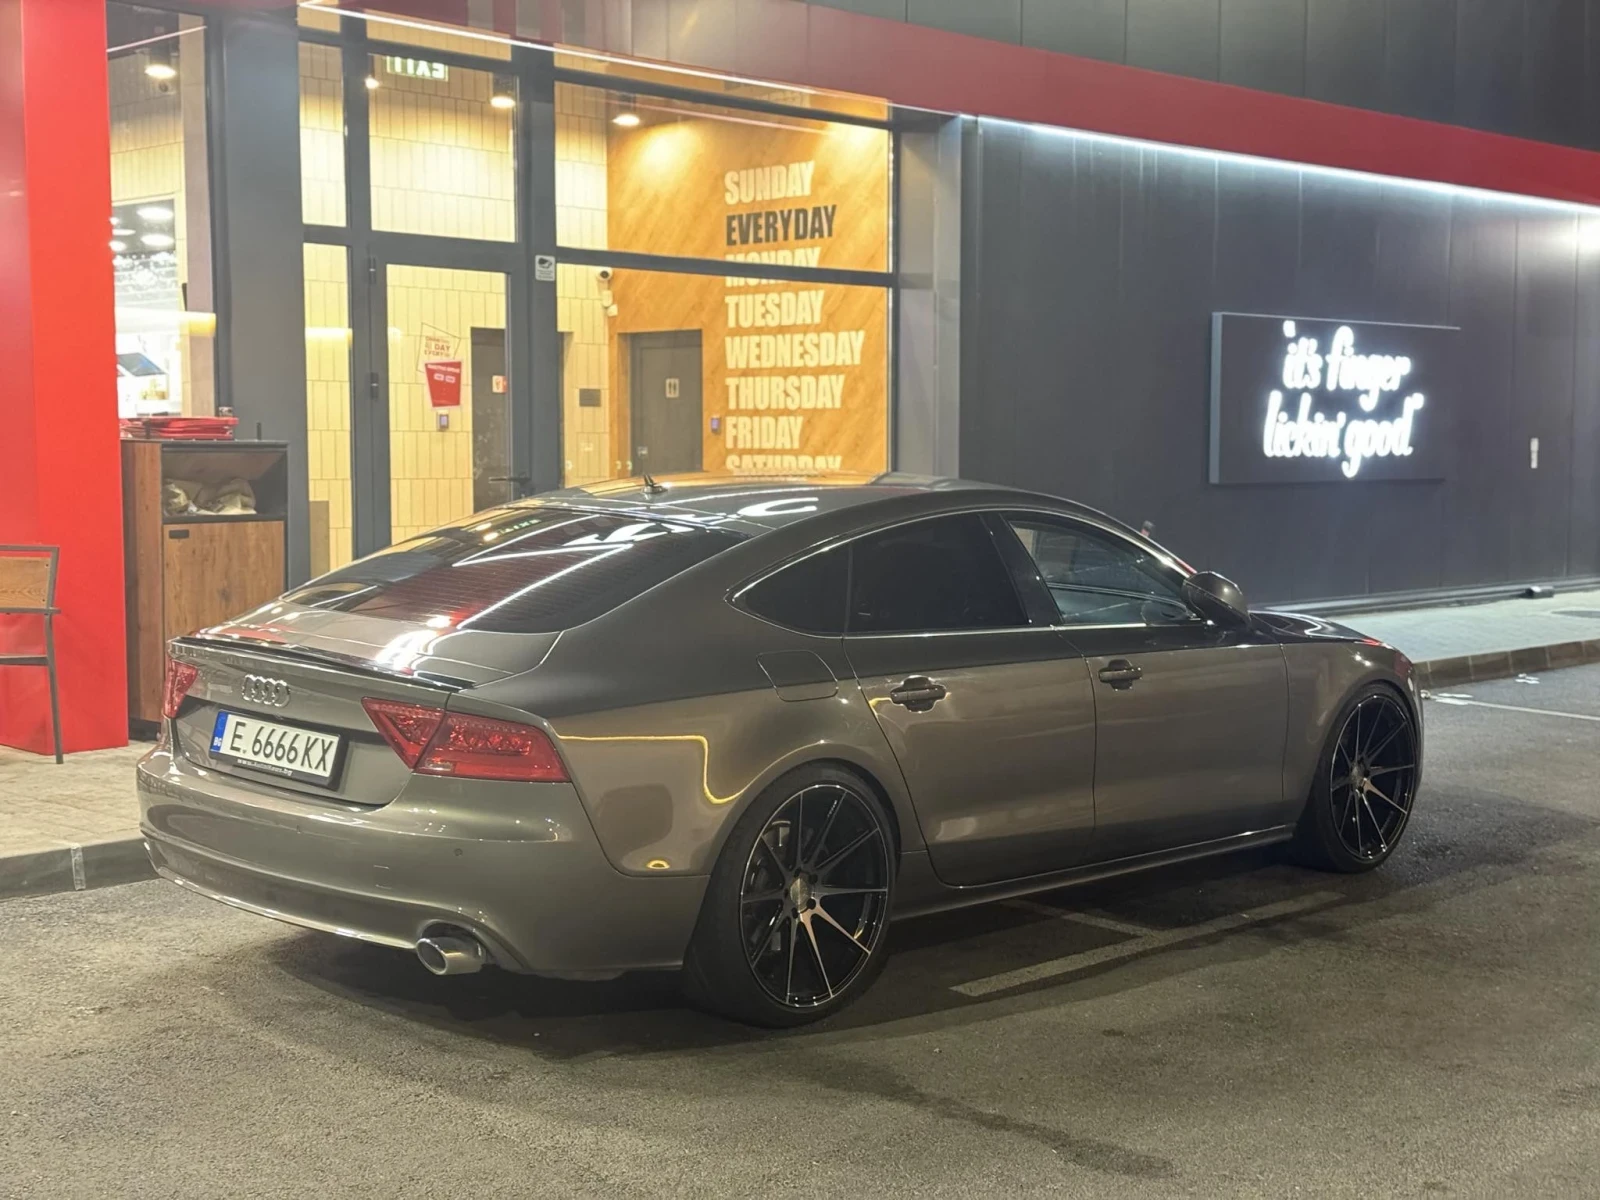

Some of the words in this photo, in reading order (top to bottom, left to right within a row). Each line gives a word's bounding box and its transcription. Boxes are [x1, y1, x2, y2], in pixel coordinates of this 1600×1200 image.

[725, 161, 815, 205] SUNDAY
[726, 204, 837, 246] EVERYDAY
[725, 290, 825, 328] TUESDAY
[725, 330, 865, 369] WEDNESDAY
[1325, 326, 1411, 412] finger
[725, 375, 845, 410] THURSDAY
[726, 416, 803, 449] FRIDAY
